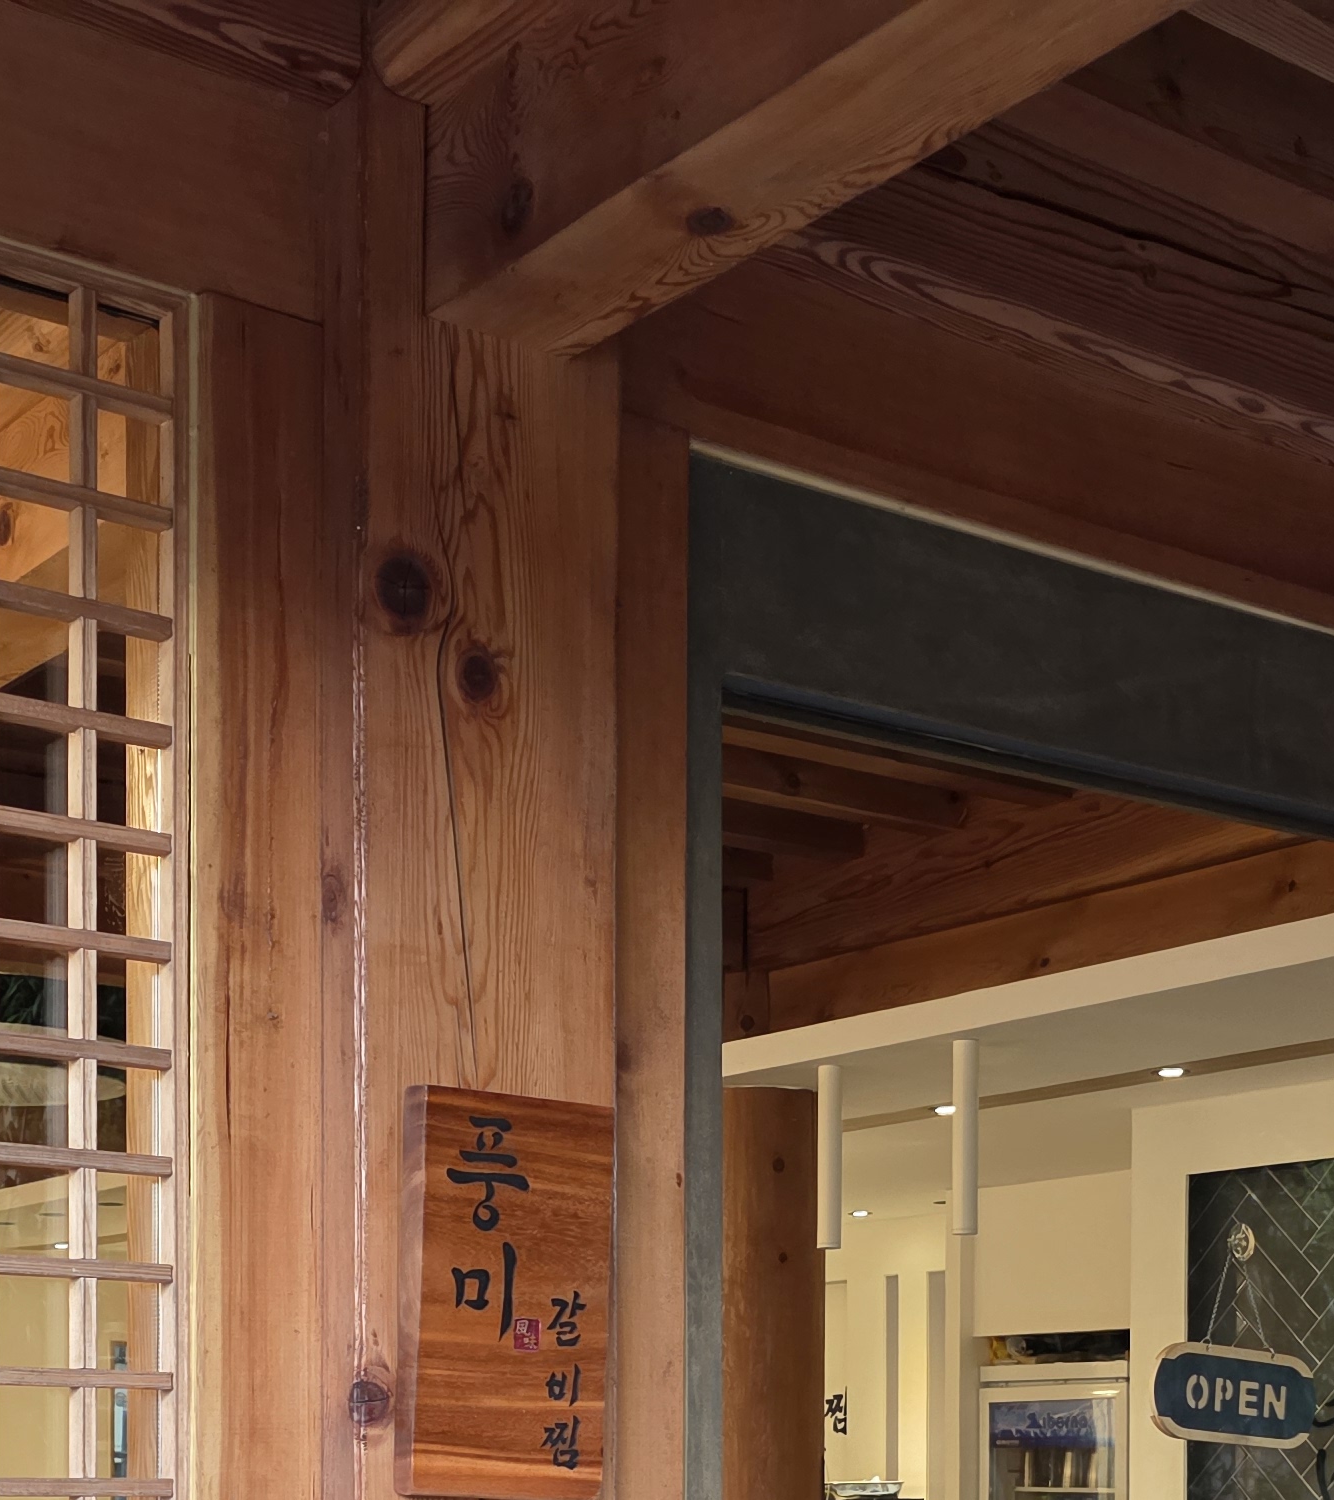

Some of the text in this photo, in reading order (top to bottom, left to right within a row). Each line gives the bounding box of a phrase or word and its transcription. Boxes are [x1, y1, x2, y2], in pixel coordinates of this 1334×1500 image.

[446, 1115, 530, 1342] 풍미
[540, 1291, 587, 1470] 갈비찜
[1186, 1374, 1287, 1420] OPEN
